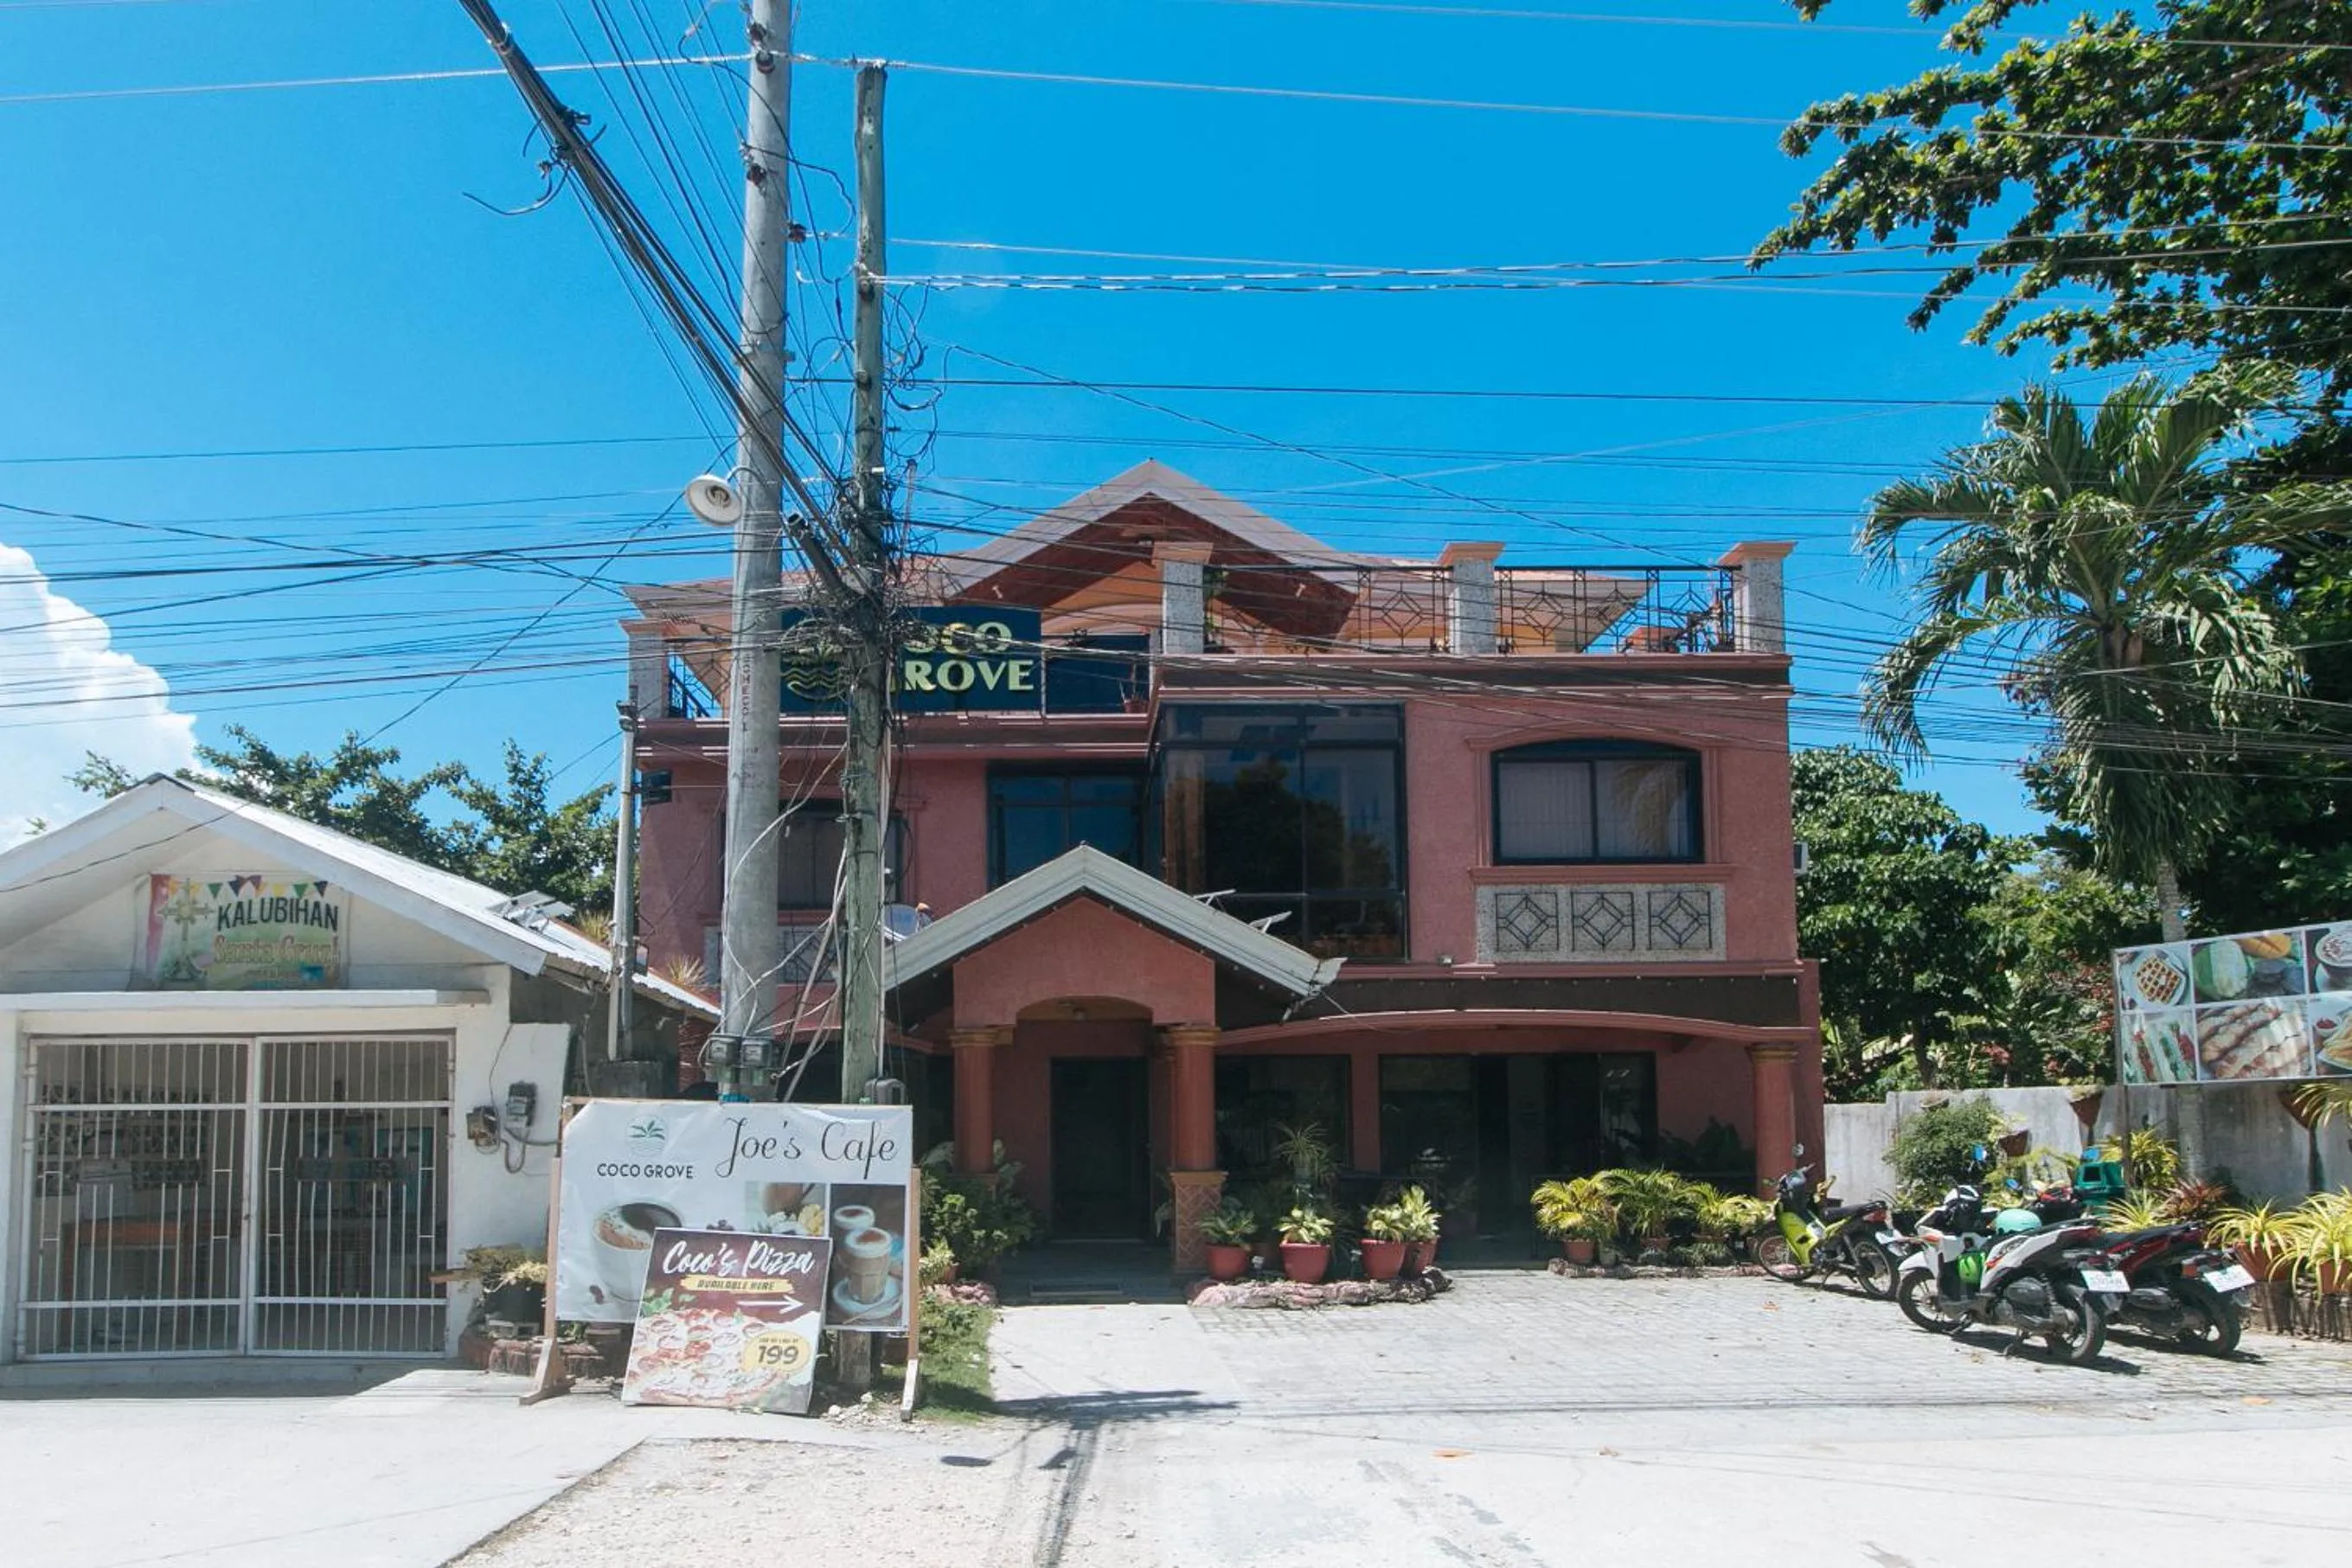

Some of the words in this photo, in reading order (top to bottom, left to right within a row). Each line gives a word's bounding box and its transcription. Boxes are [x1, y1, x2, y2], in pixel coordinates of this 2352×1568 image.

[889, 658, 1035, 692] ROVE
[217, 897, 339, 932] KALUBIHAN
[715, 1117, 804, 1178] Joe's
[820, 1119, 898, 1180] Cafe
[597, 1163, 641, 1177] COCO
[644, 1164, 695, 1180] GROVE
[663, 1238, 737, 1277] Coco's
[743, 1240, 815, 1278] Pizza
[758, 1344, 799, 1365] 199
